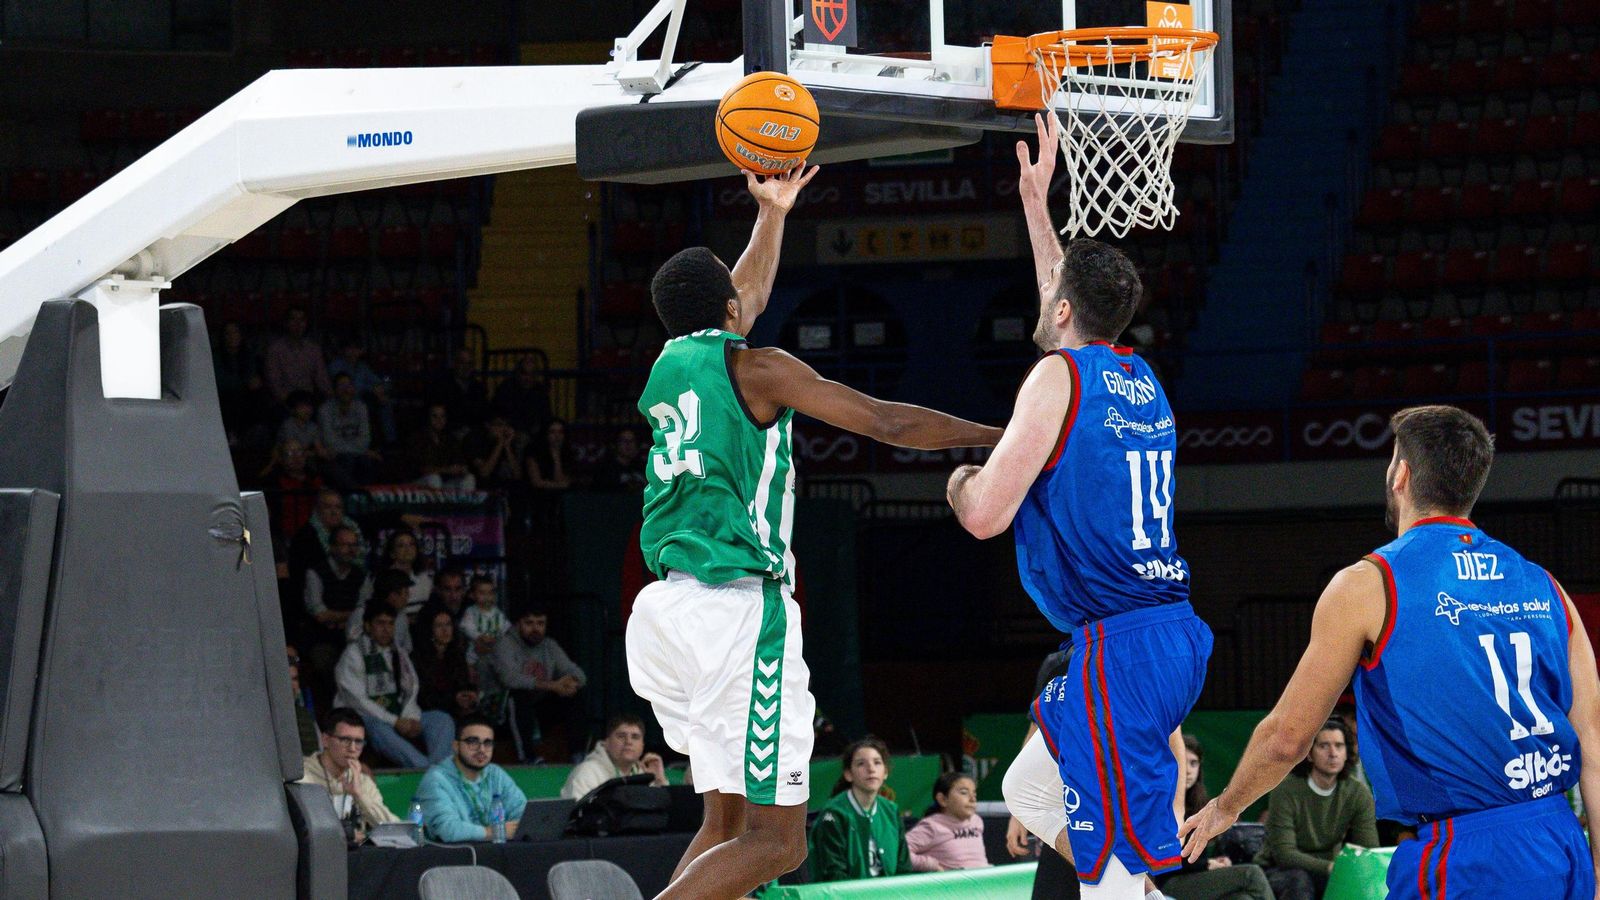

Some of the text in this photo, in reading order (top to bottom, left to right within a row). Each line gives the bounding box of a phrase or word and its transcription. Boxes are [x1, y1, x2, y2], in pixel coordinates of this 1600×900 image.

[358, 131, 413, 148] MONDO
[759, 121, 801, 141] EVO
[864, 177, 977, 204] SEVILLA
[1126, 450, 1172, 551] 14
[1522, 597, 1551, 612] salud
[1478, 632, 1555, 741] 11
